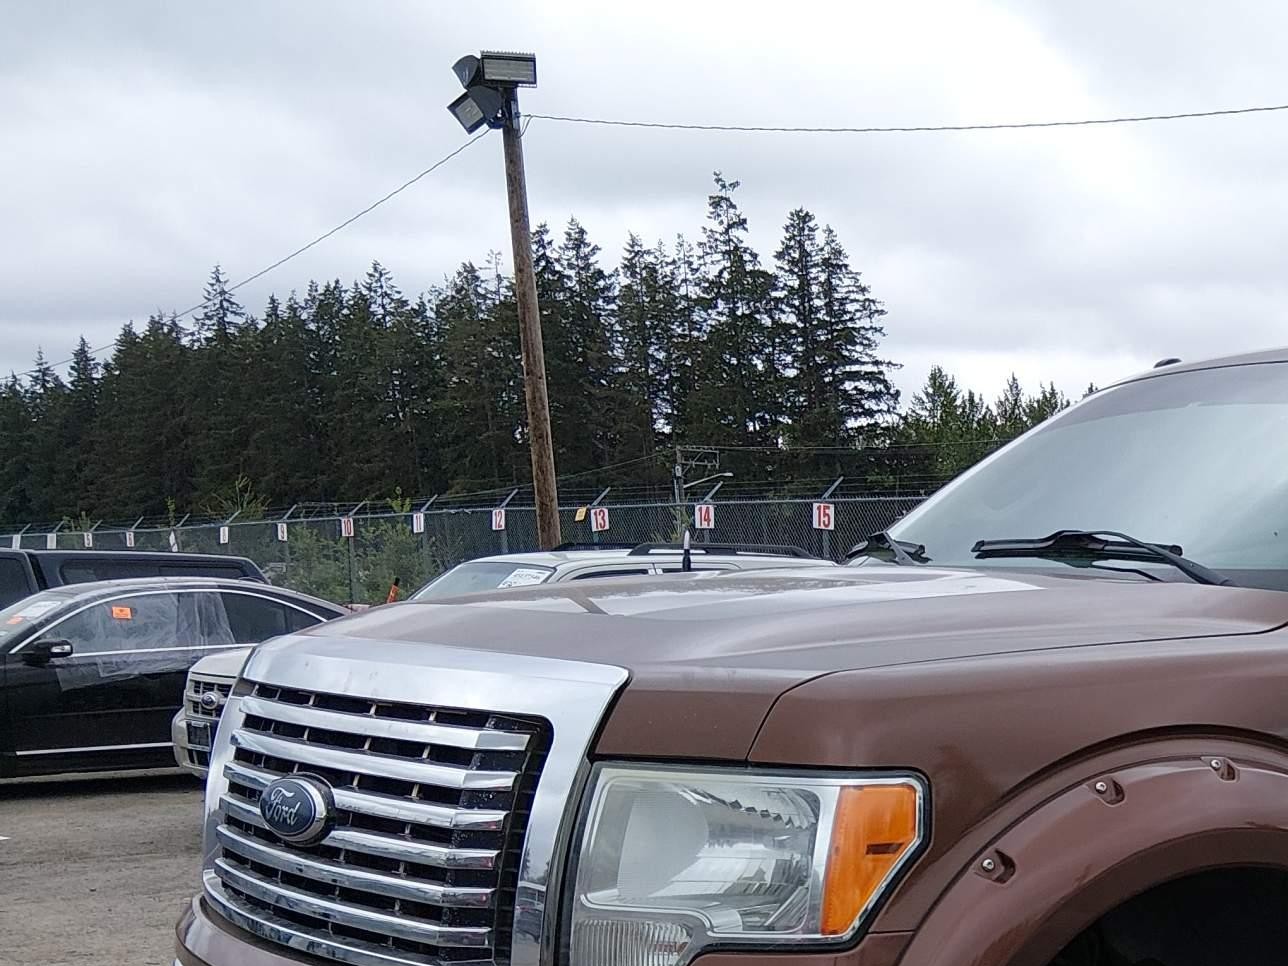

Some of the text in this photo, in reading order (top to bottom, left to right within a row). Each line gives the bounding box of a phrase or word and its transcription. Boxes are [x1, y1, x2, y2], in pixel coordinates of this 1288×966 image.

[414, 514, 422, 532] 11
[494, 510, 503, 528] 12
[593, 509, 606, 529] 13
[697, 506, 712, 527] 14
[816, 504, 831, 528] 15
[343, 519, 352, 536] 10
[265, 786, 301, 826] Ford
